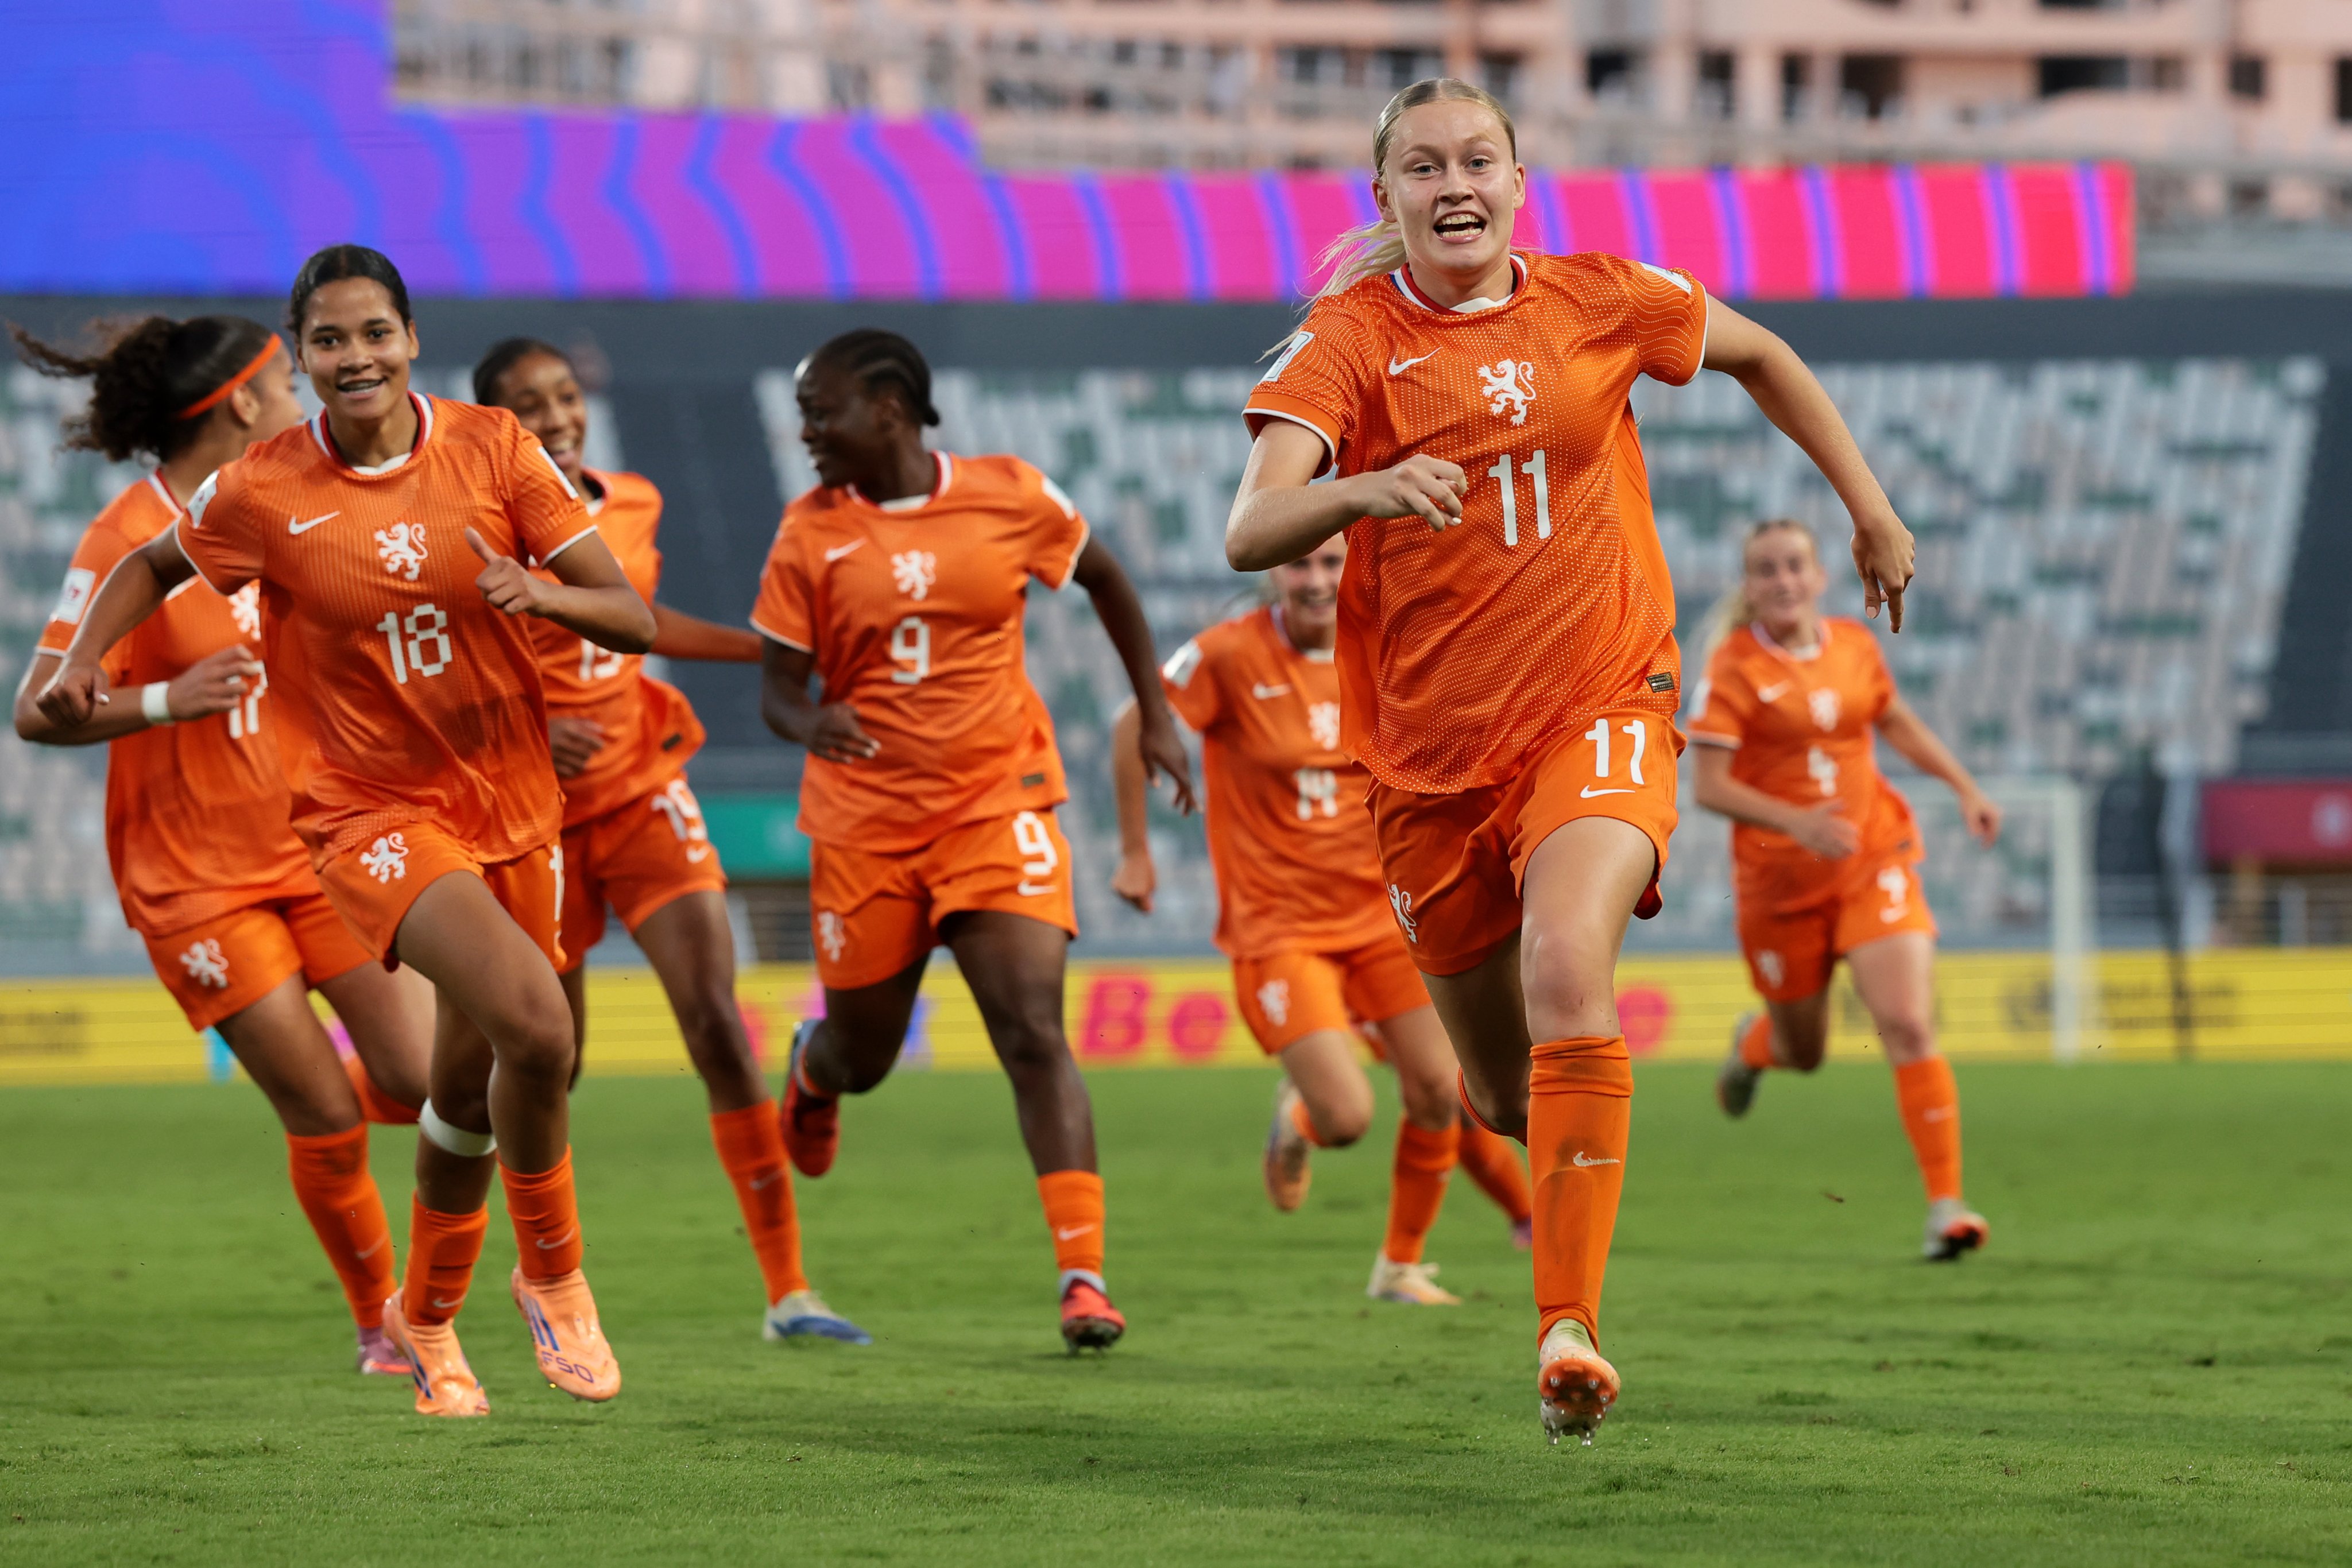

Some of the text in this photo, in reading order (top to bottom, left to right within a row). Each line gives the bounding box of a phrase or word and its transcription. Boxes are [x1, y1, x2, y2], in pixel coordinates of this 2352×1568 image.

[1488, 449, 1551, 547] 11
[377, 603, 453, 685] 18
[891, 615, 930, 685] 9
[1585, 718, 1646, 785] 11
[1807, 745, 1839, 796] 4
[651, 779, 709, 842] 19
[1294, 768, 1338, 821] 14
[1012, 810, 1059, 876] 9
